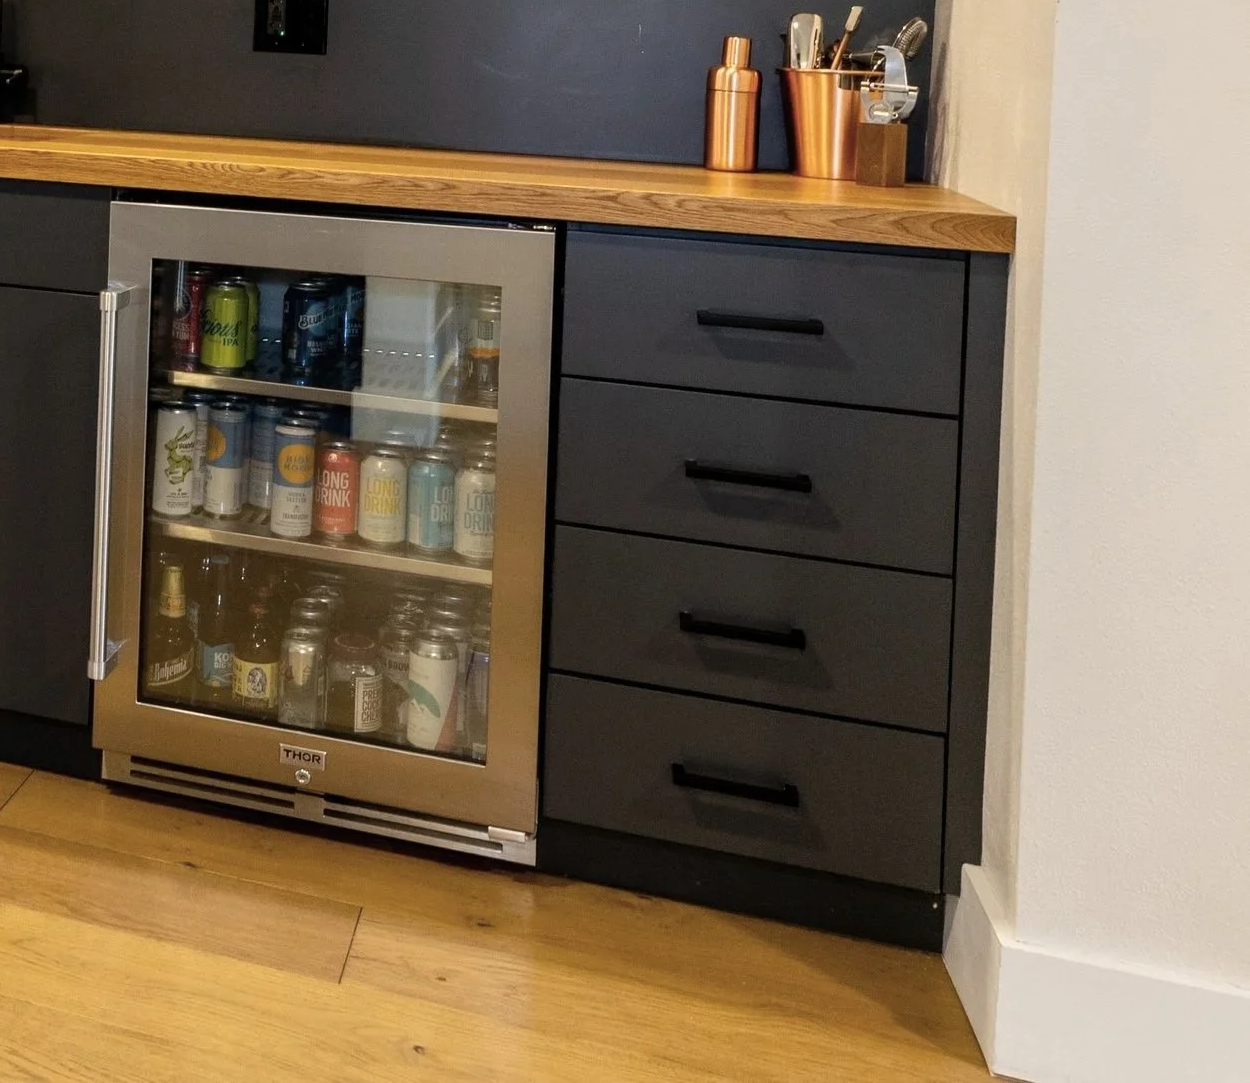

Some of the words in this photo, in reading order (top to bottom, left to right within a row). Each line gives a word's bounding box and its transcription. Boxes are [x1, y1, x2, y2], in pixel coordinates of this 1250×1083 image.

[222, 339, 239, 347] IPA
[317, 467, 350, 490] LONG
[366, 478, 402, 496] LONG
[315, 486, 351, 508] DRINK
[363, 493, 402, 515] DRINK
[154, 657, 188, 681] Bohemia
[283, 748, 321, 765] THOR
